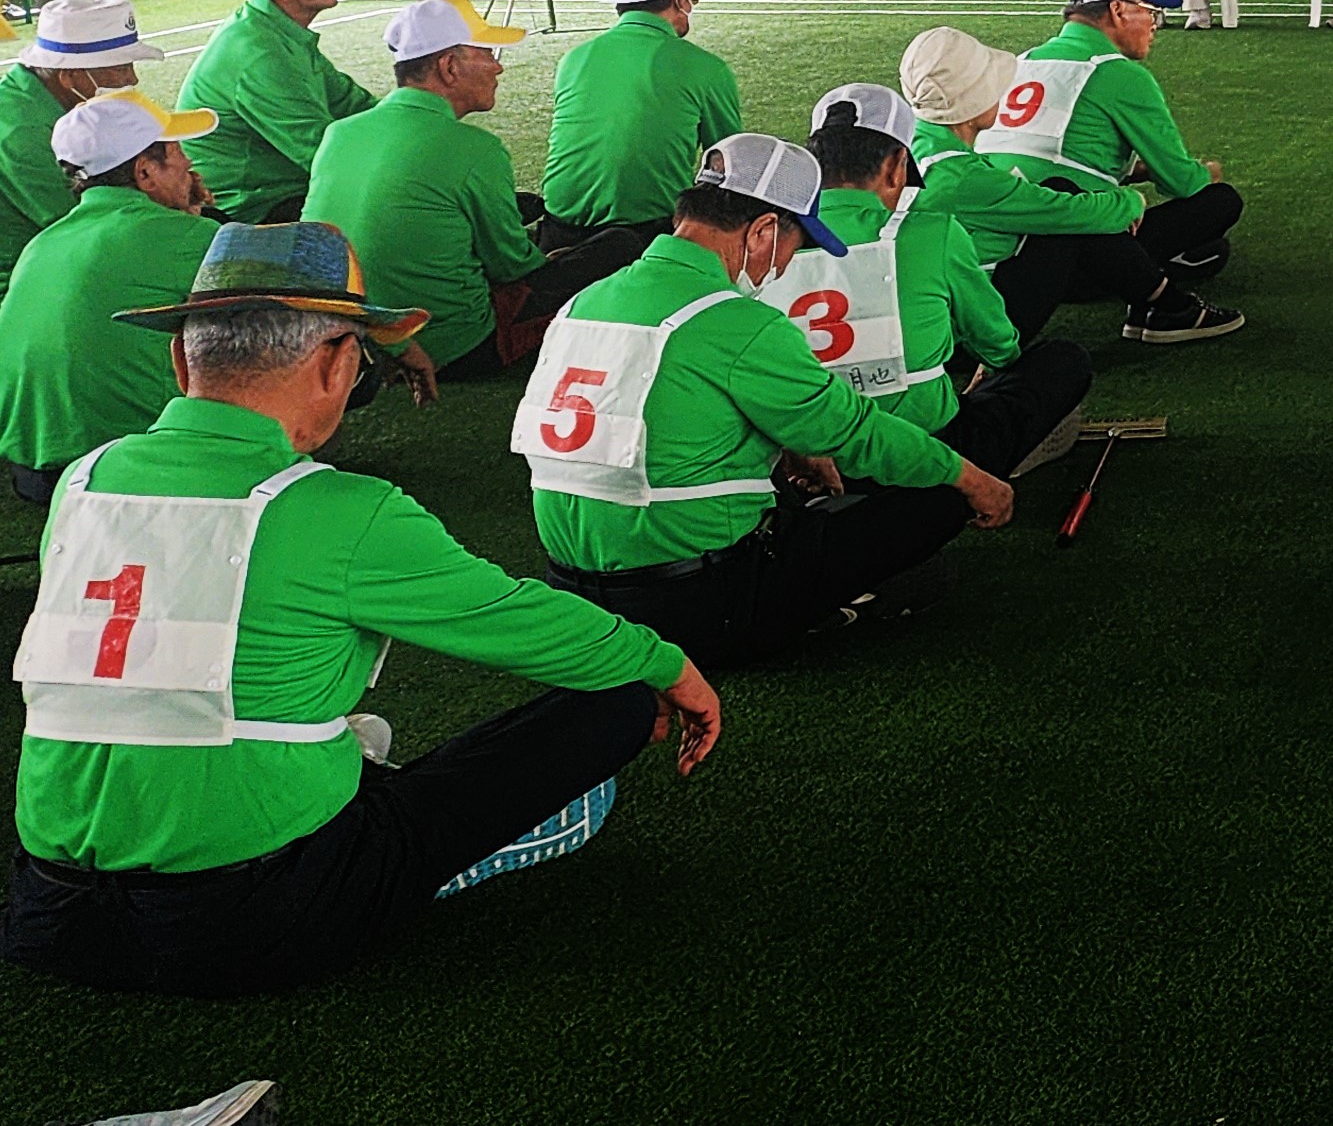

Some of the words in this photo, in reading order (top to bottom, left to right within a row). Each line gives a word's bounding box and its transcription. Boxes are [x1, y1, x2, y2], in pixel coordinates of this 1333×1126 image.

[1000, 81, 1045, 128] 9
[788, 289, 855, 363] 3
[541, 367, 607, 453] 5
[84, 564, 146, 679] 1
